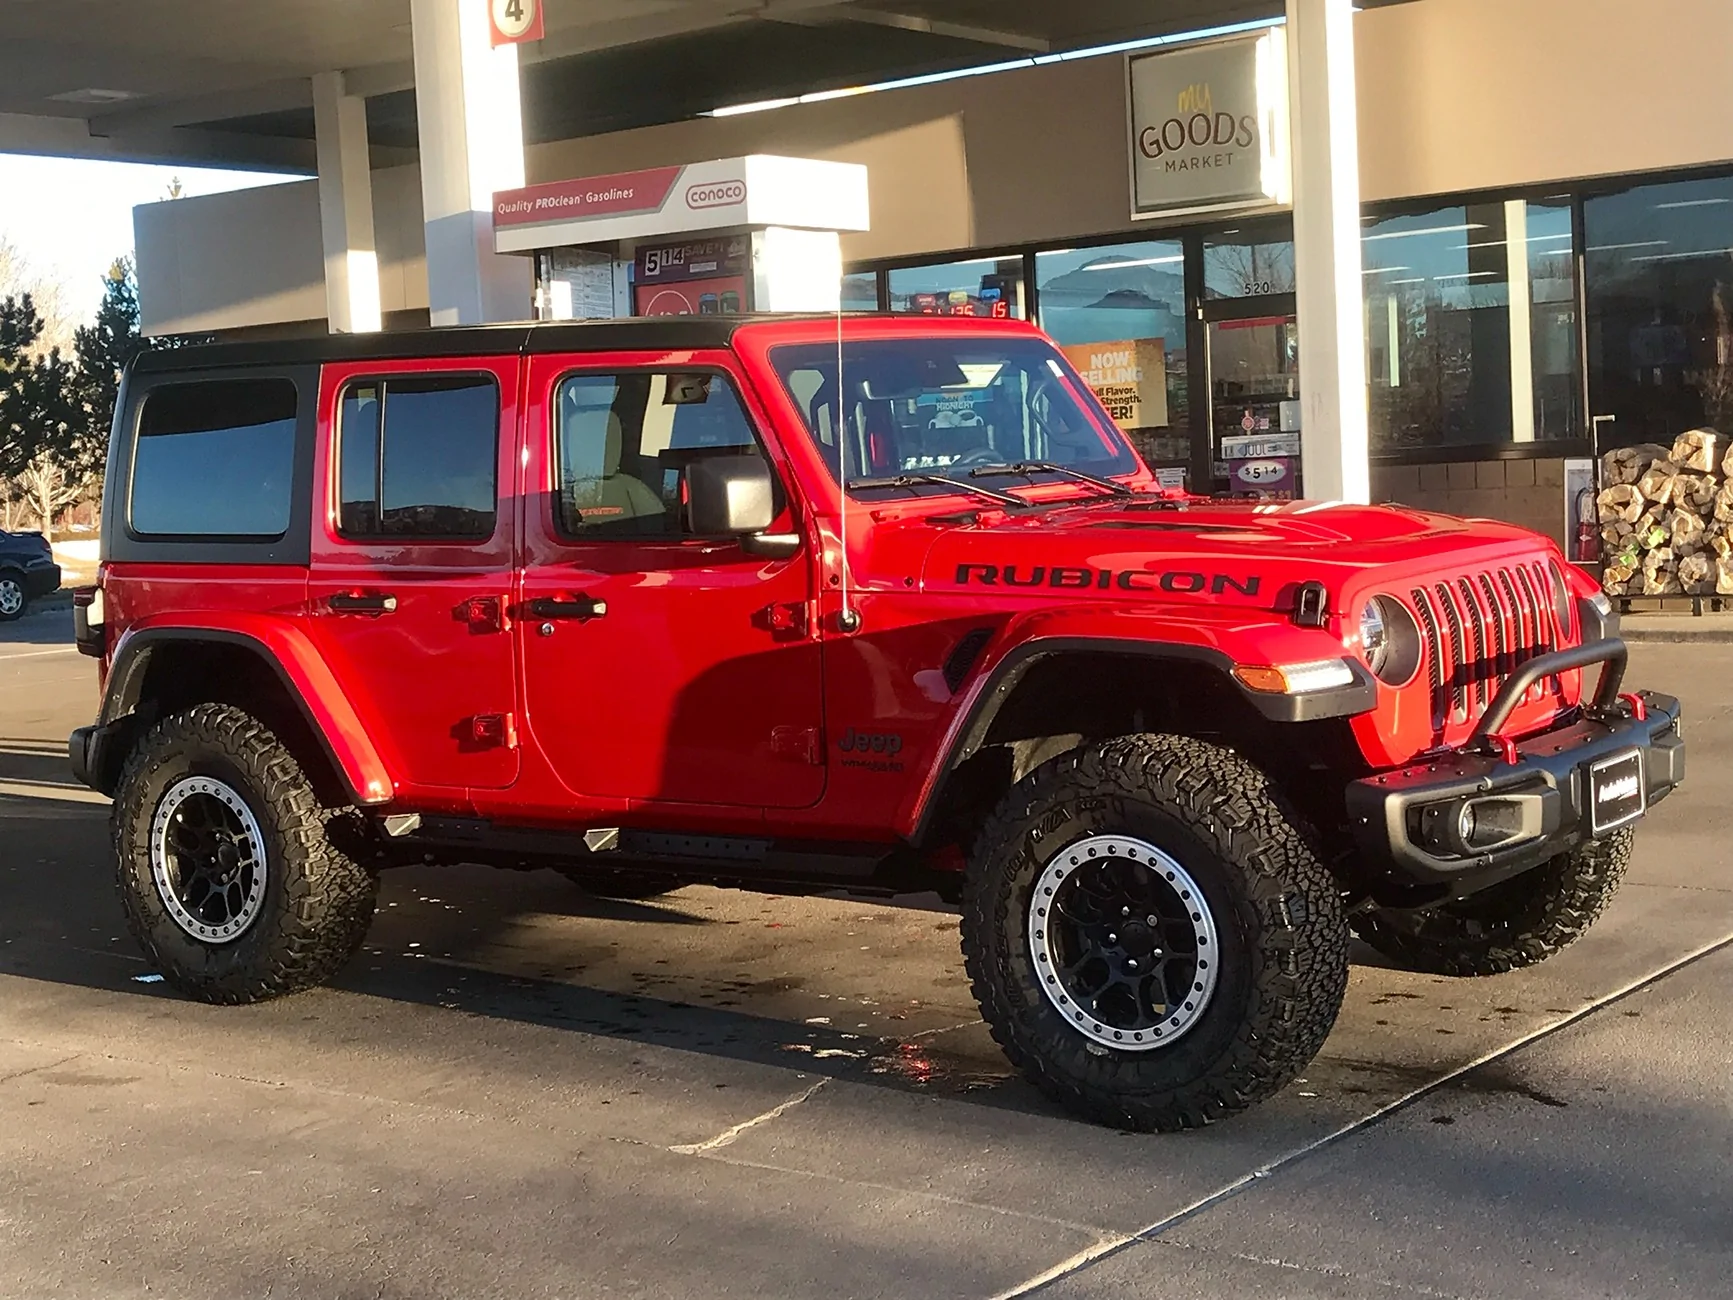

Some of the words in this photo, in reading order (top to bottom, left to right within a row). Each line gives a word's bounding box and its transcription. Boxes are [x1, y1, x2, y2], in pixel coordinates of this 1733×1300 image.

[505, 0, 524, 22] 4
[1177, 83, 1212, 117] my
[1139, 112, 1256, 158] GOODS
[1165, 152, 1234, 173] MARKET
[498, 201, 533, 214] Quality
[586, 188, 634, 203] Gasolines
[691, 186, 742, 202] conoco
[1244, 281, 1270, 295] 520
[1090, 351, 1130, 369] NOW
[1081, 367, 1143, 386] SELLING
[1101, 394, 1142, 406] Strength.
[1105, 387, 1136, 396] Flavor.
[955, 563, 1262, 596] RUBICON
[838, 727, 903, 757] Jeep
